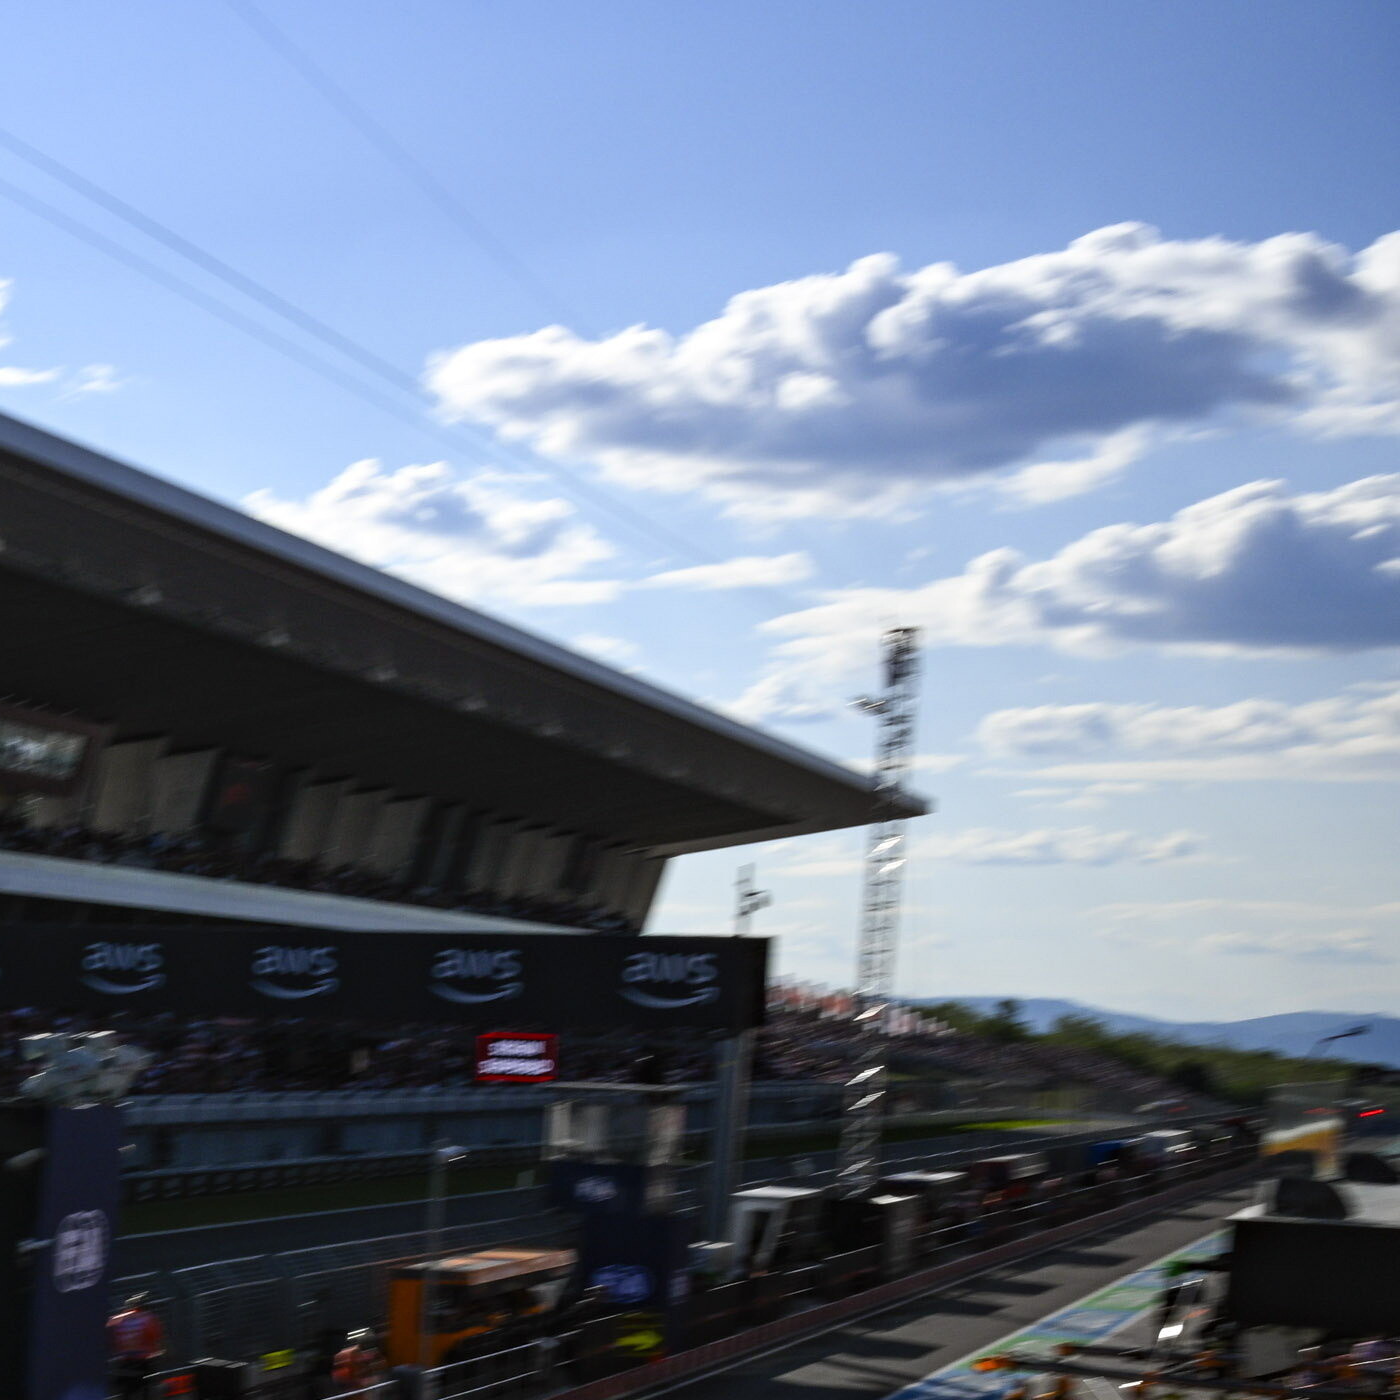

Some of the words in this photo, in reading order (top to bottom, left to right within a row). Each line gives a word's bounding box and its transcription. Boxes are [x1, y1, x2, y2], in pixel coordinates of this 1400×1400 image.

[250, 944, 340, 977] aws
[429, 948, 524, 981] aws
[620, 951, 720, 985] aws
